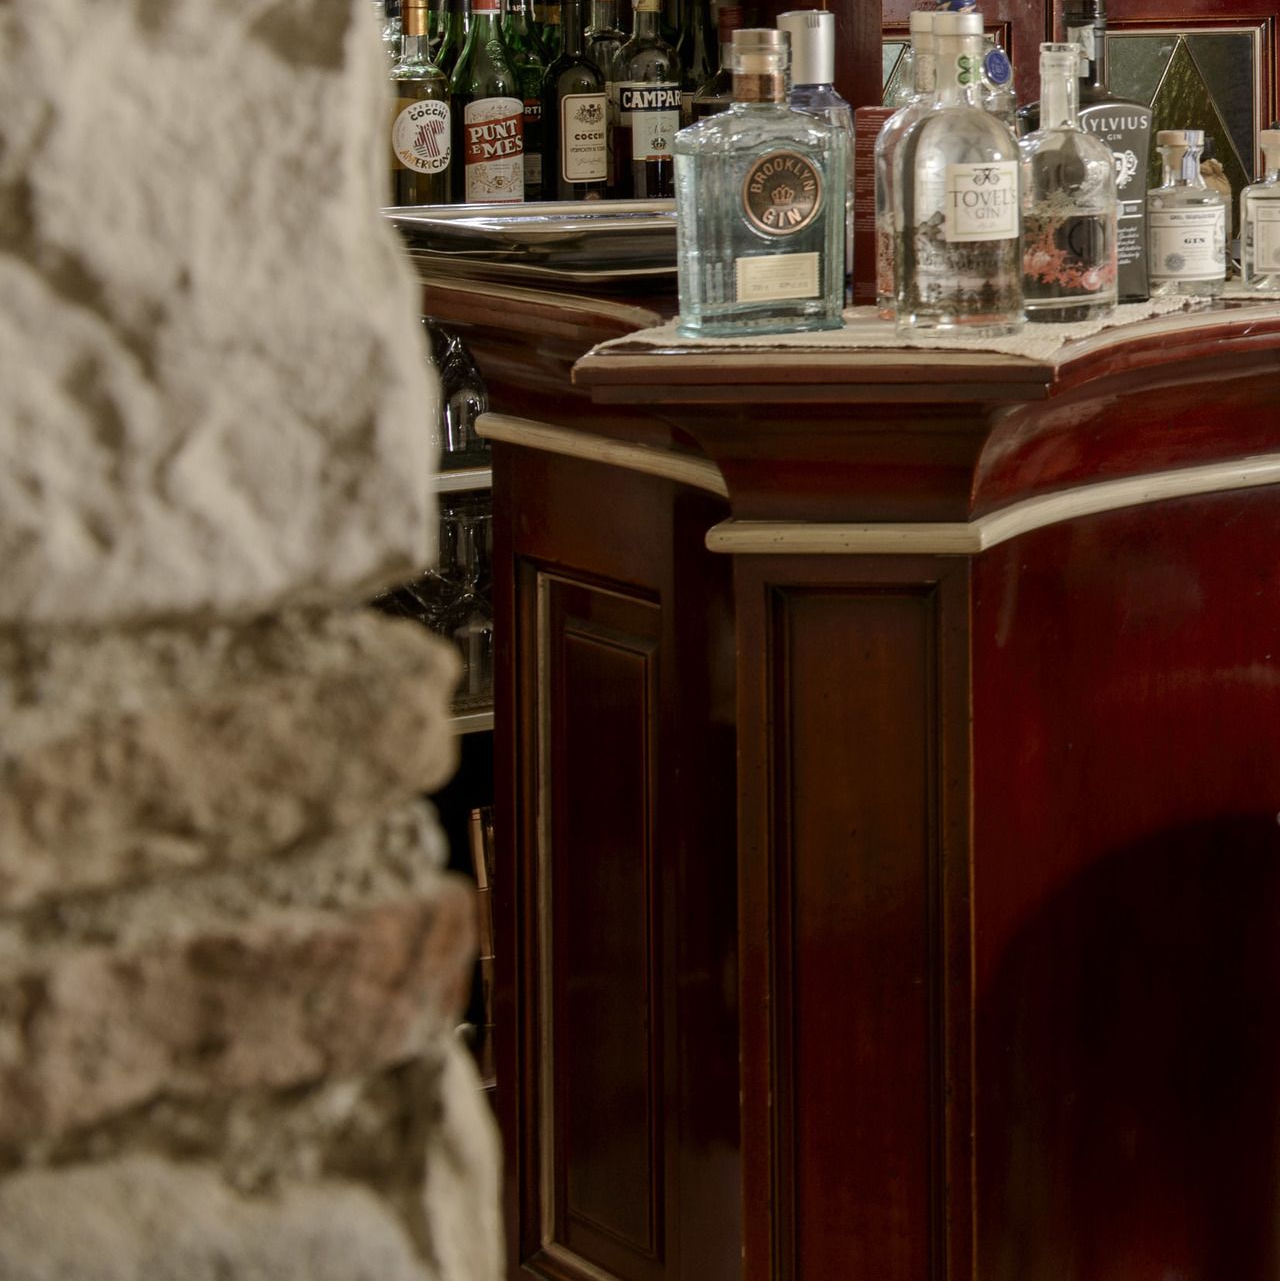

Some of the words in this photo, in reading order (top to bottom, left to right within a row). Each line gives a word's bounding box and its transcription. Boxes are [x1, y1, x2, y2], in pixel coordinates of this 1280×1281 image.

[410, 108, 447, 121] COCCHI
[1081, 113, 1148, 132] SYLVIUS
[469, 119, 517, 143] PUNT
[1107, 133, 1122, 141] GIN
[482, 134, 523, 158] MES
[400, 146, 450, 169] AMERICANO
[750, 158, 816, 194] BROOKLYN
[762, 207, 802, 227] GIN
[975, 207, 1000, 220] GIN
